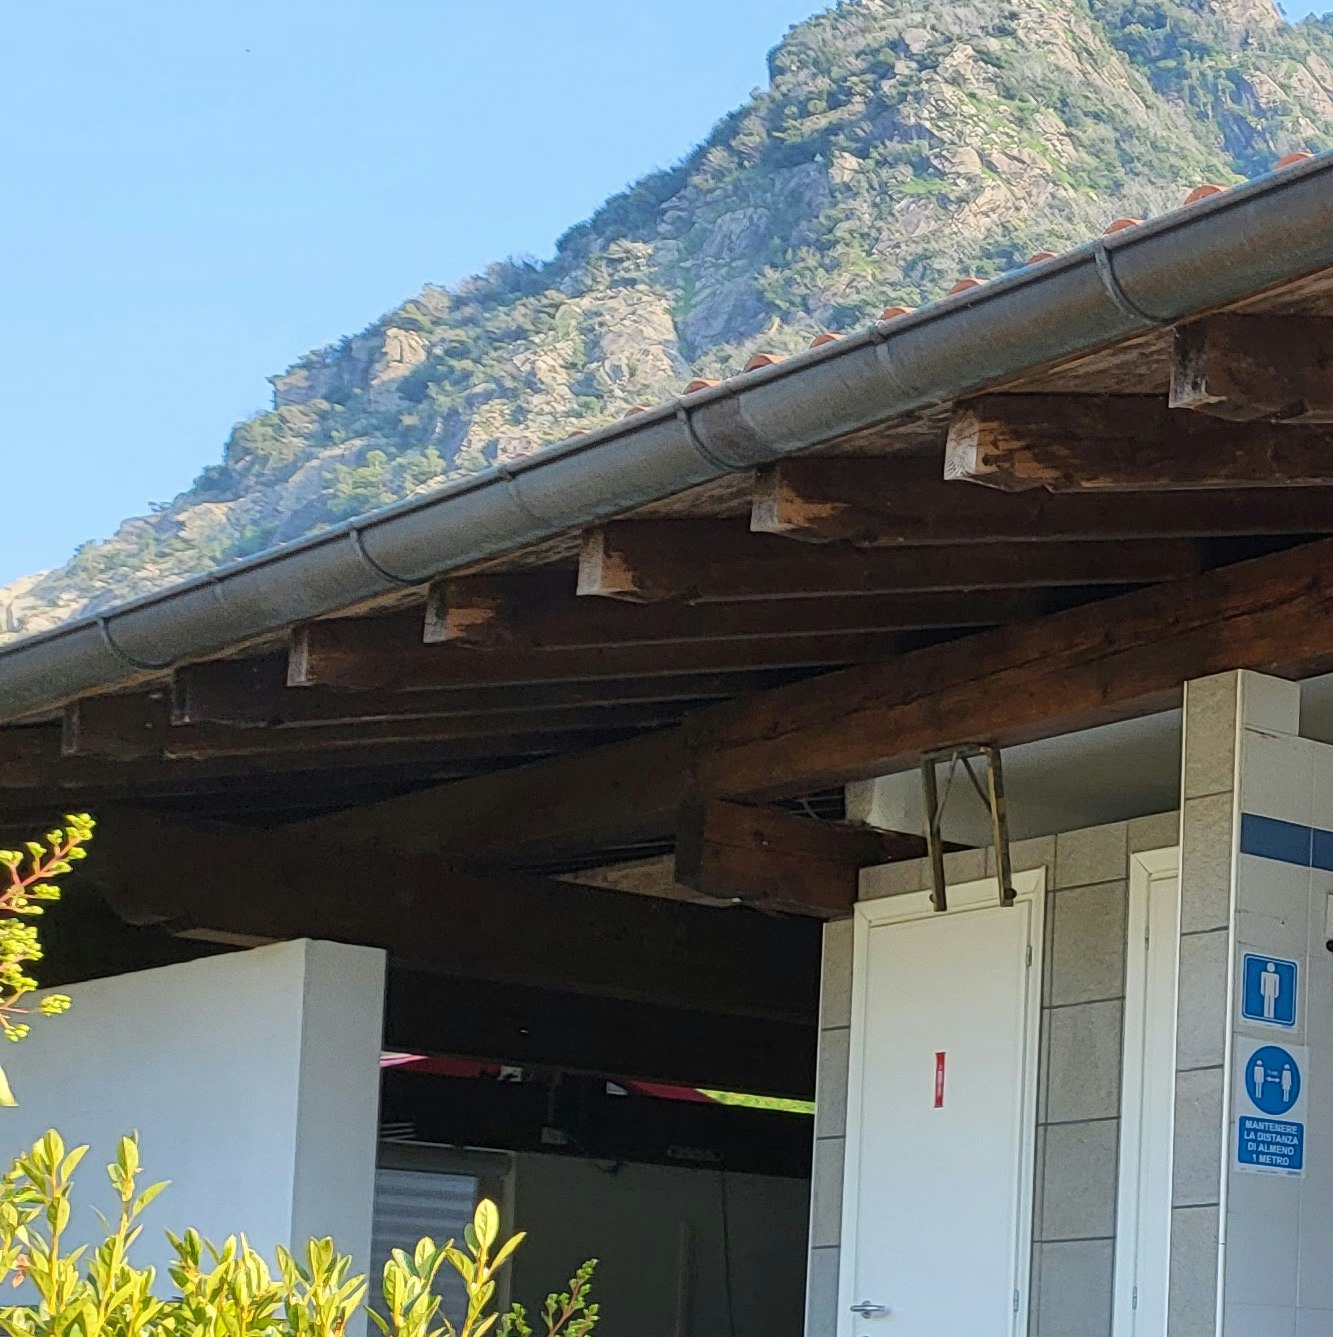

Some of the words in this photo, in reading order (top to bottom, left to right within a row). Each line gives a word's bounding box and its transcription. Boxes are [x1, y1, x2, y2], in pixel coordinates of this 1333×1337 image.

[1245, 1119, 1298, 1135] MANTENERE
[1243, 1130, 1255, 1140] LA
[1257, 1132, 1299, 1146] DISTANZA
[1247, 1141, 1257, 1151] DI
[1257, 1142, 1295, 1156] ALMENO
[1252, 1153, 1257, 1162] 1
[1259, 1154, 1290, 1166] METRO
